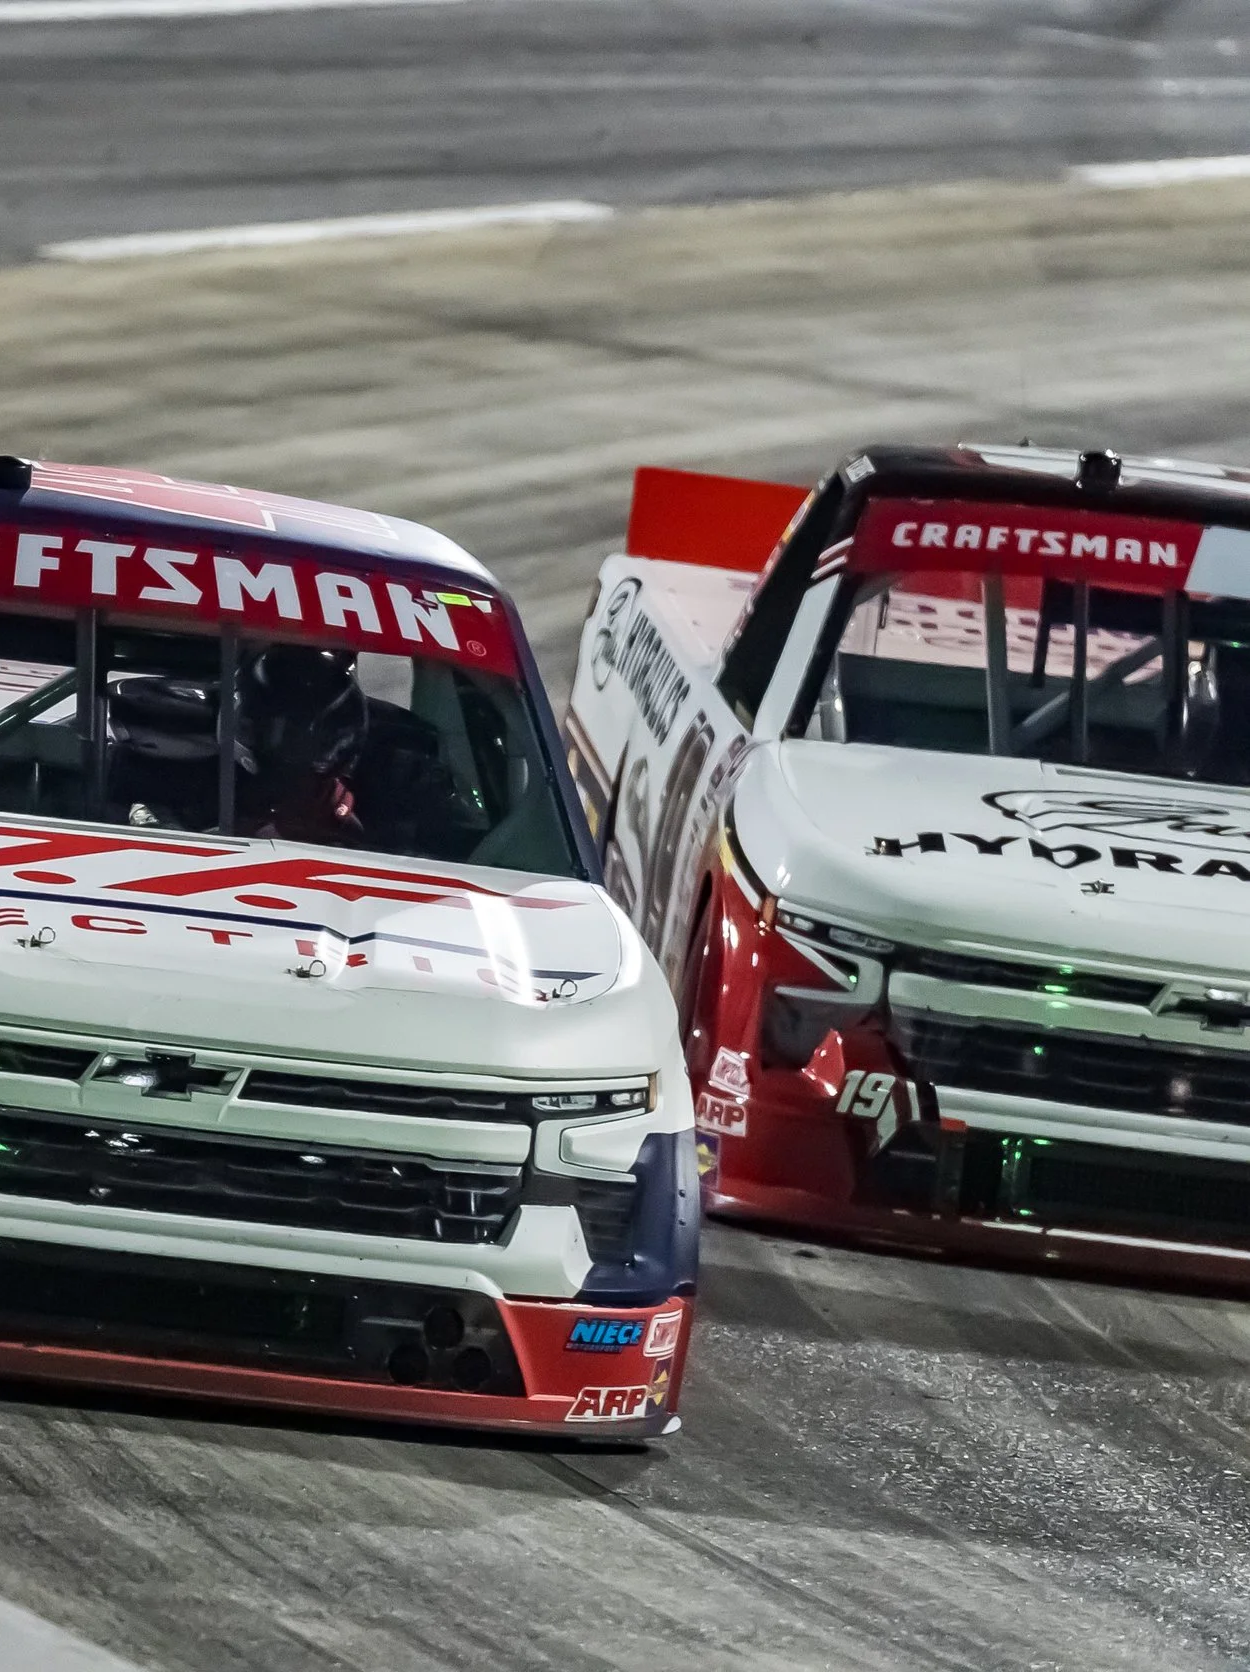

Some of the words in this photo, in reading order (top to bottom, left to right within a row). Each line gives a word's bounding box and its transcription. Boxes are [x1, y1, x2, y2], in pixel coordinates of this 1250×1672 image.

[891, 521, 1179, 567] CRAFTSMAN
[835, 1069, 896, 1119] 19
[570, 1388, 647, 1417] ARP
